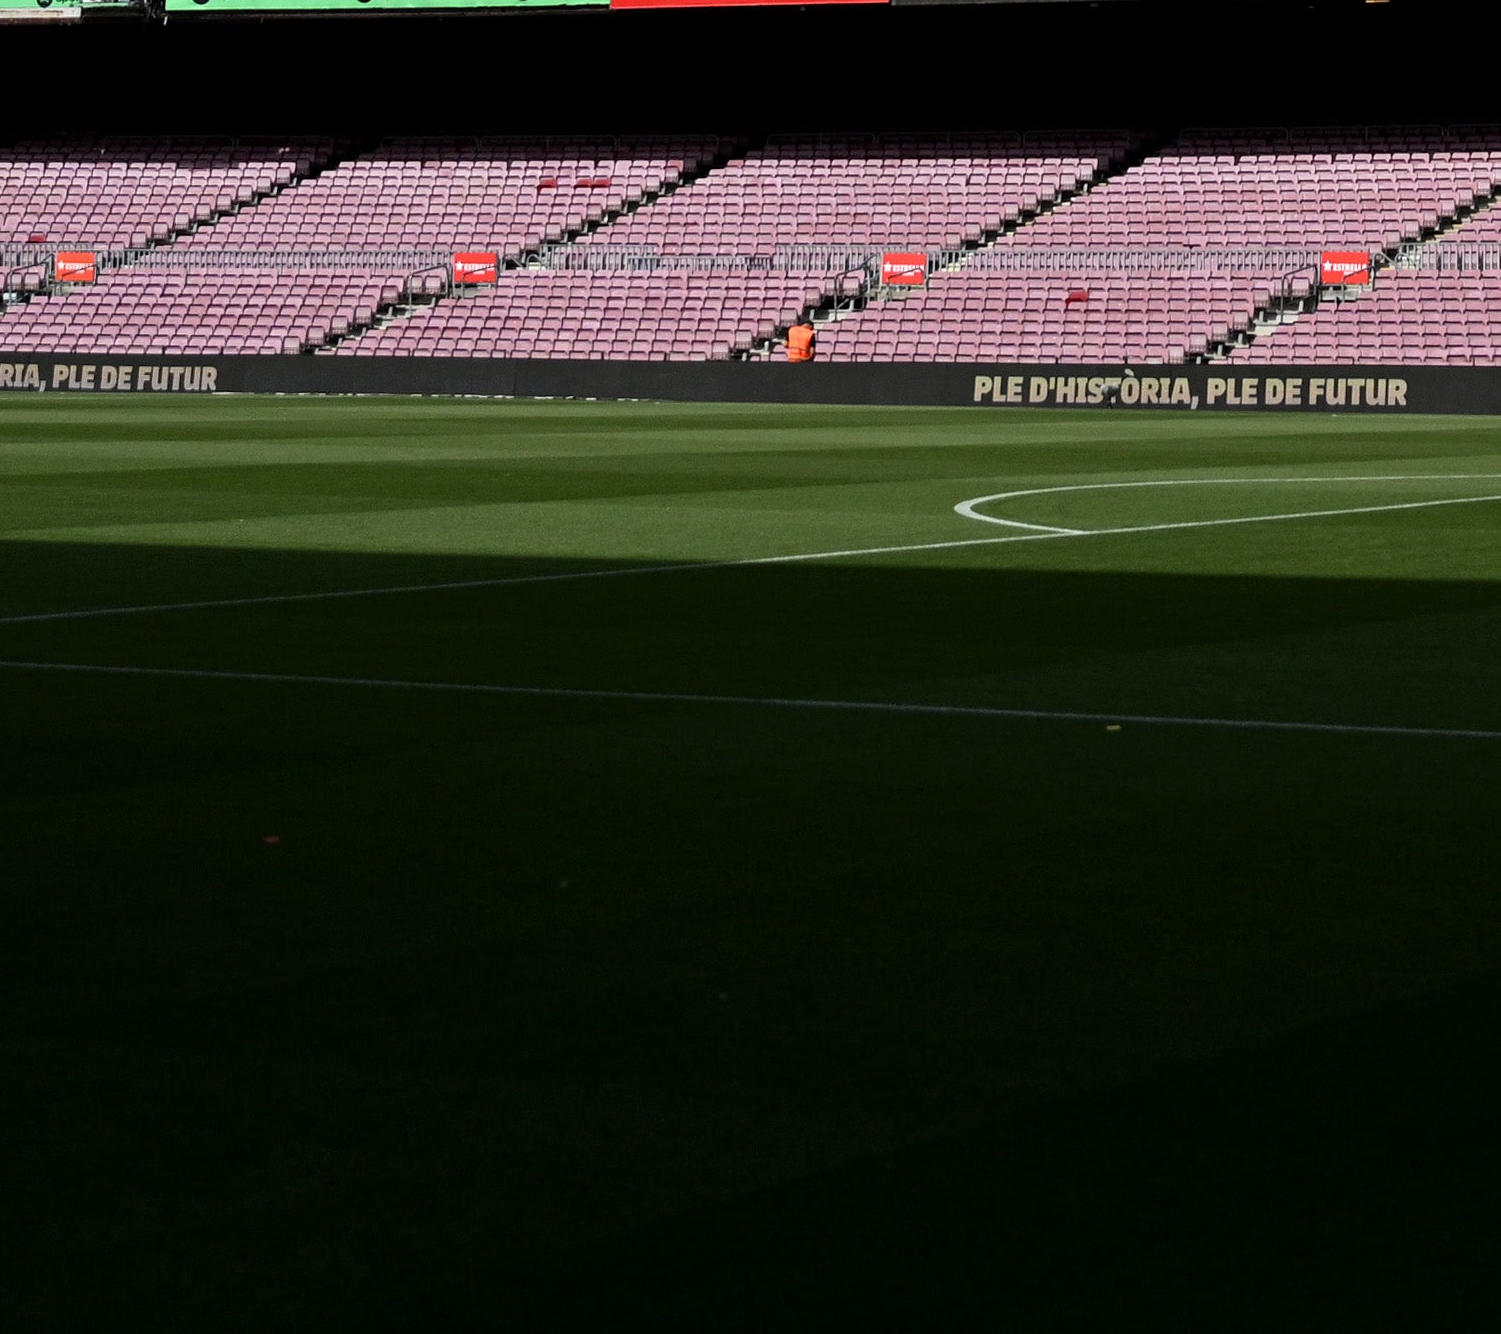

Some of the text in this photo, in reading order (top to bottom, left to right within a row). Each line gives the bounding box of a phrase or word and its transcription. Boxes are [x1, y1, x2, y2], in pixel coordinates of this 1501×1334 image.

[52, 364, 96, 388] PLE
[99, 365, 133, 390] DE
[136, 366, 218, 391] FUTUR
[973, 376, 1023, 402] PLE
[1207, 378, 1258, 404] PLE
[1264, 378, 1303, 404] DE
[1309, 379, 1407, 406] FUTUR
